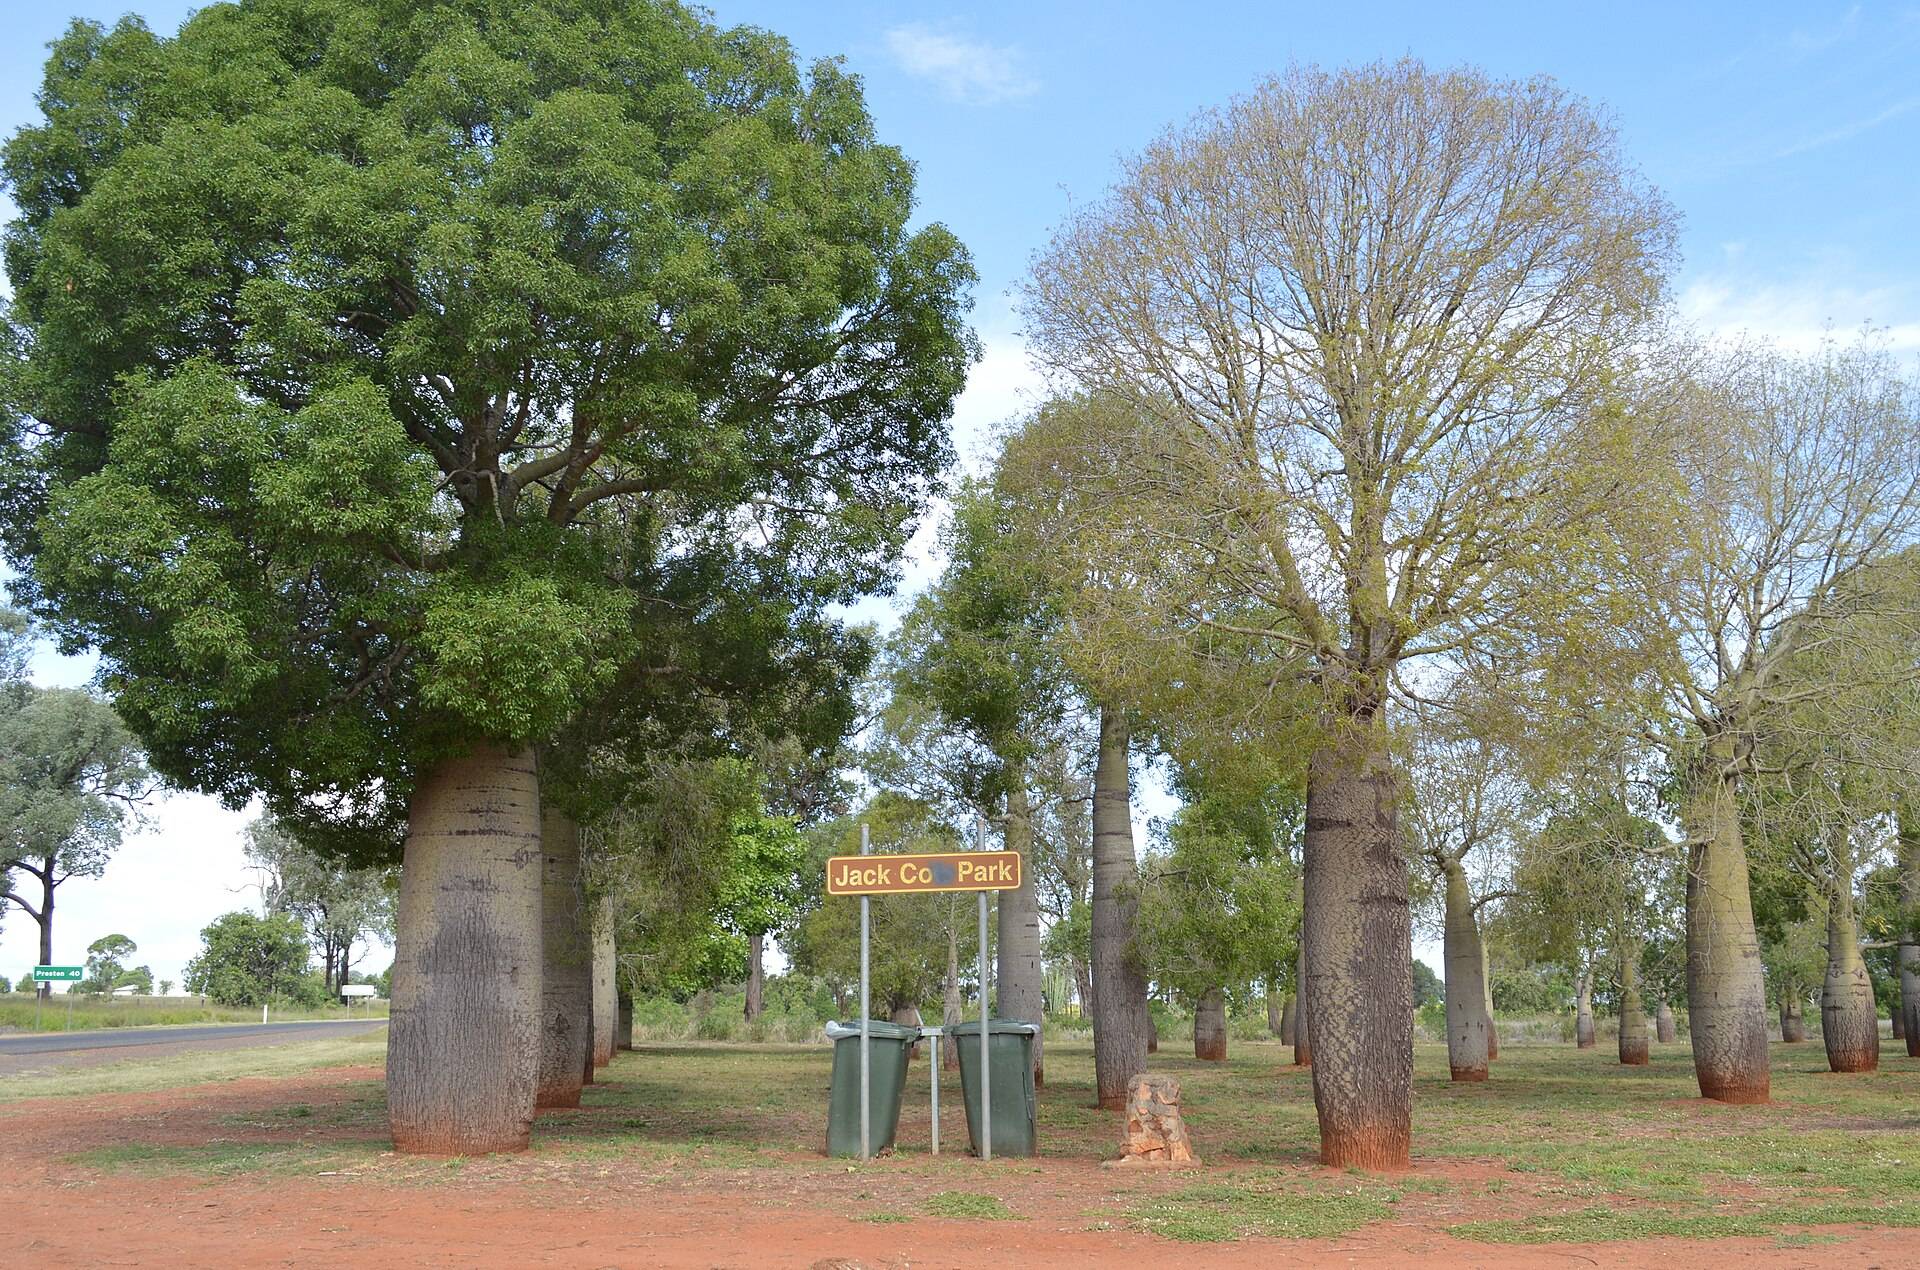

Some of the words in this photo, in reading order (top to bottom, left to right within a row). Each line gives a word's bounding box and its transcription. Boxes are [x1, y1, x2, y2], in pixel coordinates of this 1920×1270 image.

[835, 864, 891, 887] Jack
[899, 862, 951, 884] Co
[957, 860, 1013, 883] Park
